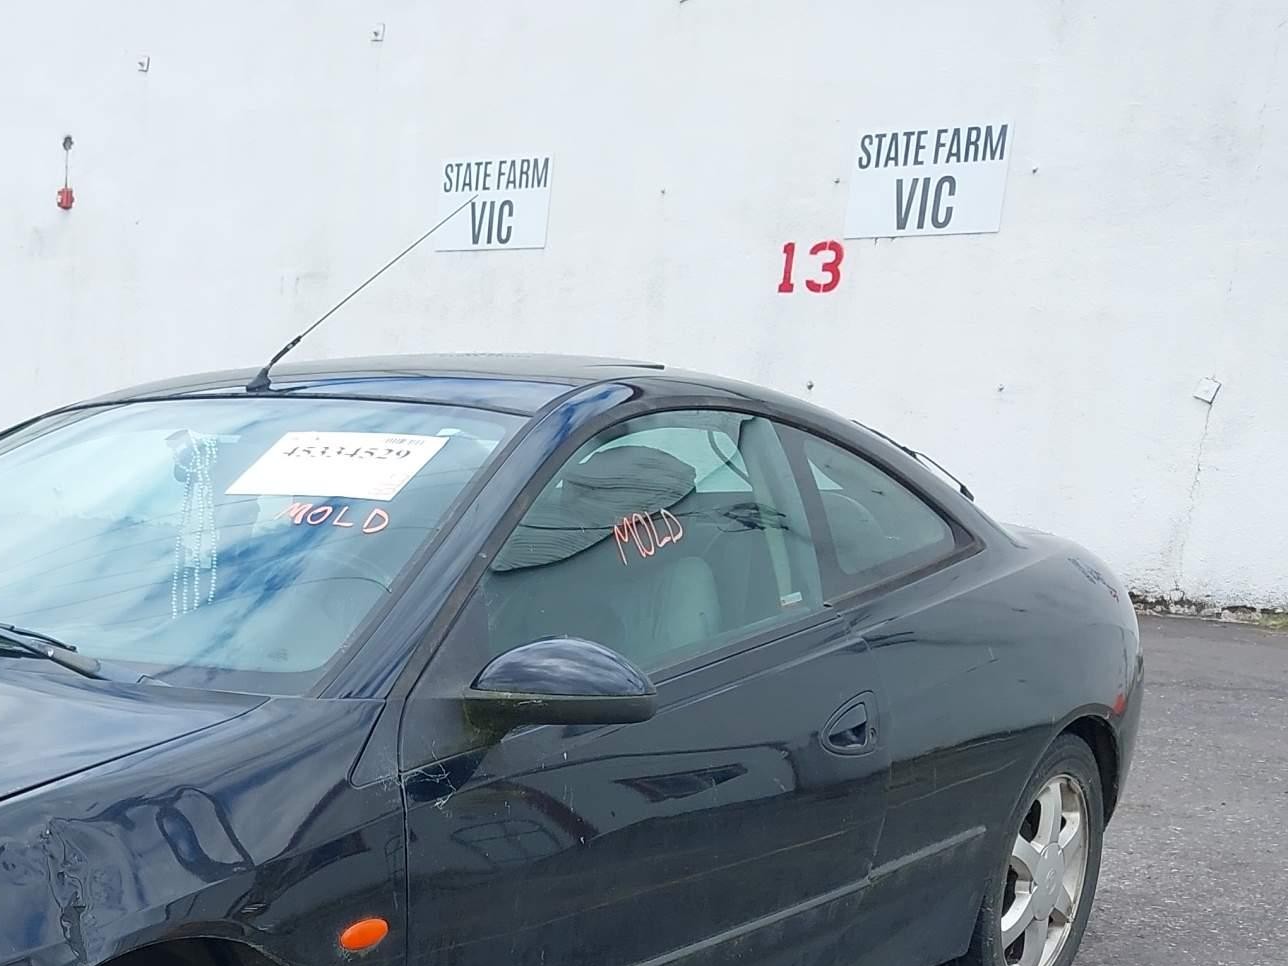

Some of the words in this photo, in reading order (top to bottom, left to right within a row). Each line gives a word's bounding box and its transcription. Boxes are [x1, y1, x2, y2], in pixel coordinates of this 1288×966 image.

[857, 129, 929, 170] STATE
[932, 123, 1009, 165] FARM
[443, 161, 493, 193] STATE
[496, 157, 550, 190] FARM
[470, 199, 514, 245] VIC
[895, 174, 957, 231] VIC
[777, 240, 845, 294] 13
[282, 445, 412, 460] 45334529
[275, 502, 390, 534] MOLD
[613, 507, 684, 566] MOLD
